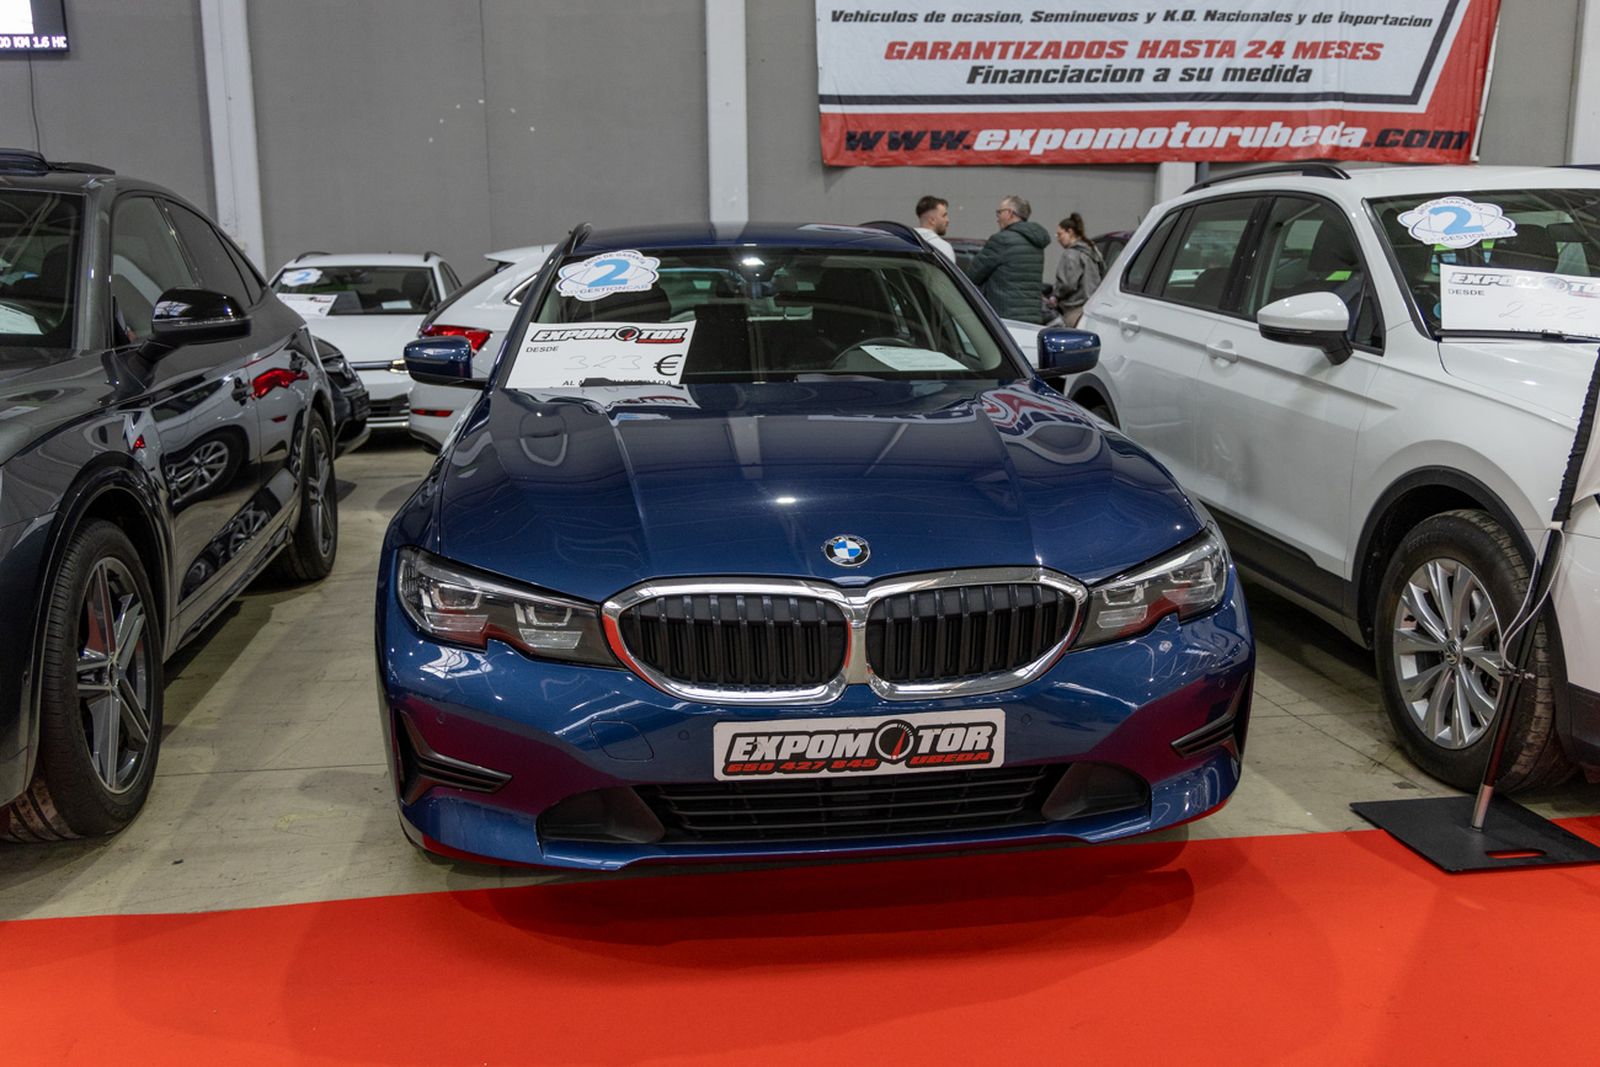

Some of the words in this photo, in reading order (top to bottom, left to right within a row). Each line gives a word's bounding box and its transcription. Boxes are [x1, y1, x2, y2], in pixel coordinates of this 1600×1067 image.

[831, 10, 917, 23] Vehiculos
[924, 10, 946, 22] de
[951, 10, 1023, 24] ocasion,
[1030, 10, 1139, 23] Seminuevos
[1143, 11, 1157, 24] y
[1203, 9, 1292, 23] Nacionales
[1296, 13, 1307, 25] y
[1311, 11, 1333, 24] de
[12, 36, 31, 48] KM
[32, 36, 50, 48] 1.6
[884, 40, 1129, 60] GARANTIZADOS
[1137, 39, 1238, 59] HASTA
[1243, 39, 1286, 60] 24
[1292, 40, 1385, 61] MESES
[966, 65, 1145, 84] Financiacion
[1153, 68, 1170, 83] a
[1179, 67, 1214, 83] su
[1221, 64, 1313, 83] medida
[845, 121, 1469, 155] www.expomotorubeda.com
[1428, 206, 1485, 236] 2
[293, 271, 312, 282] 2
[587, 259, 630, 288] 2
[1447, 288, 1485, 296] DESDE
[531, 326, 688, 343] EXPOMOTOR
[728, 721, 995, 762] EXPOMOTOR
[726, 762, 775, 773] 650
[779, 760, 827, 771] 427
[909, 751, 990, 765] UBEDA
